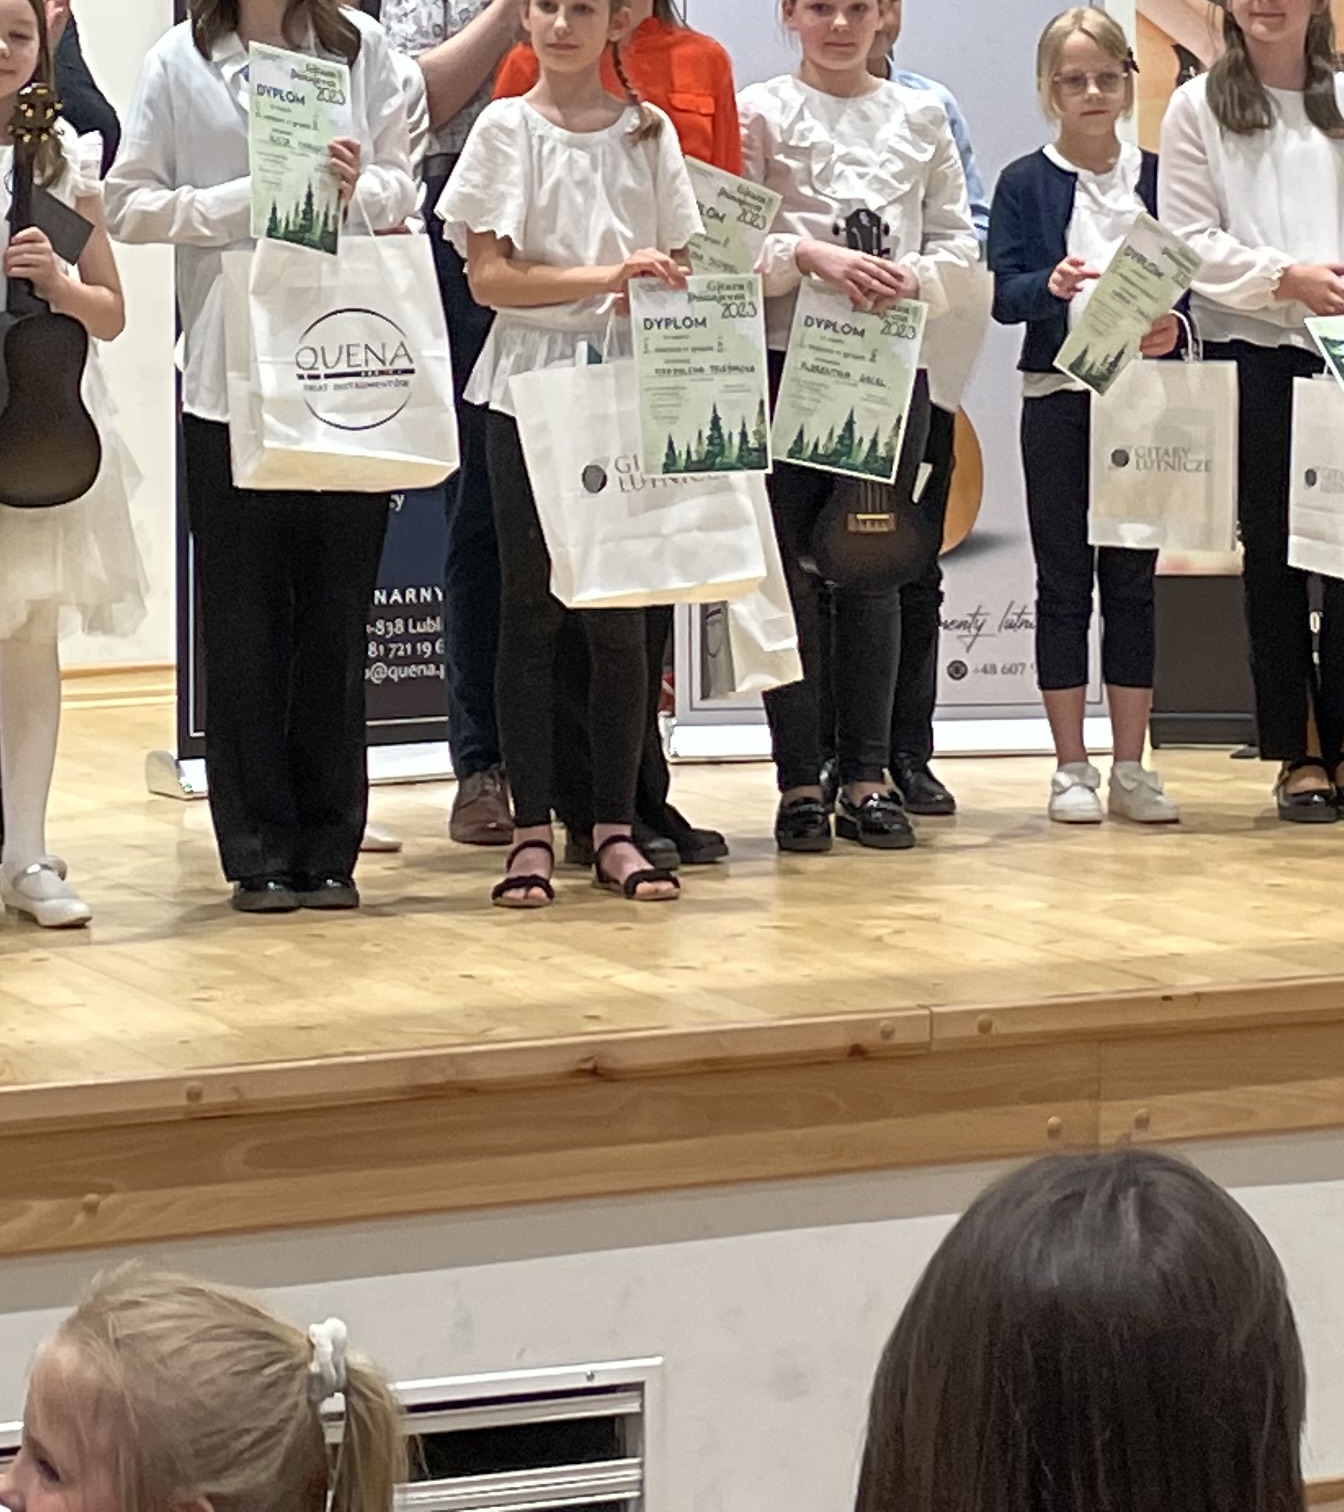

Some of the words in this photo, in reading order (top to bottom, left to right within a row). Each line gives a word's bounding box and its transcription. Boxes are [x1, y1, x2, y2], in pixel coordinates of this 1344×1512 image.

[257, 83, 305, 106] DYPLOM
[721, 302, 758, 319] 2023
[643, 317, 707, 331] DYPLOM
[803, 315, 866, 337] DYPLOM
[880, 319, 916, 340] 2023
[295, 340, 414, 370] QUENA
[1134, 445, 1191, 459] GITARY
[408, 616, 441, 634] Lubl
[388, 642, 412, 659] 721
[417, 641, 432, 658] 19
